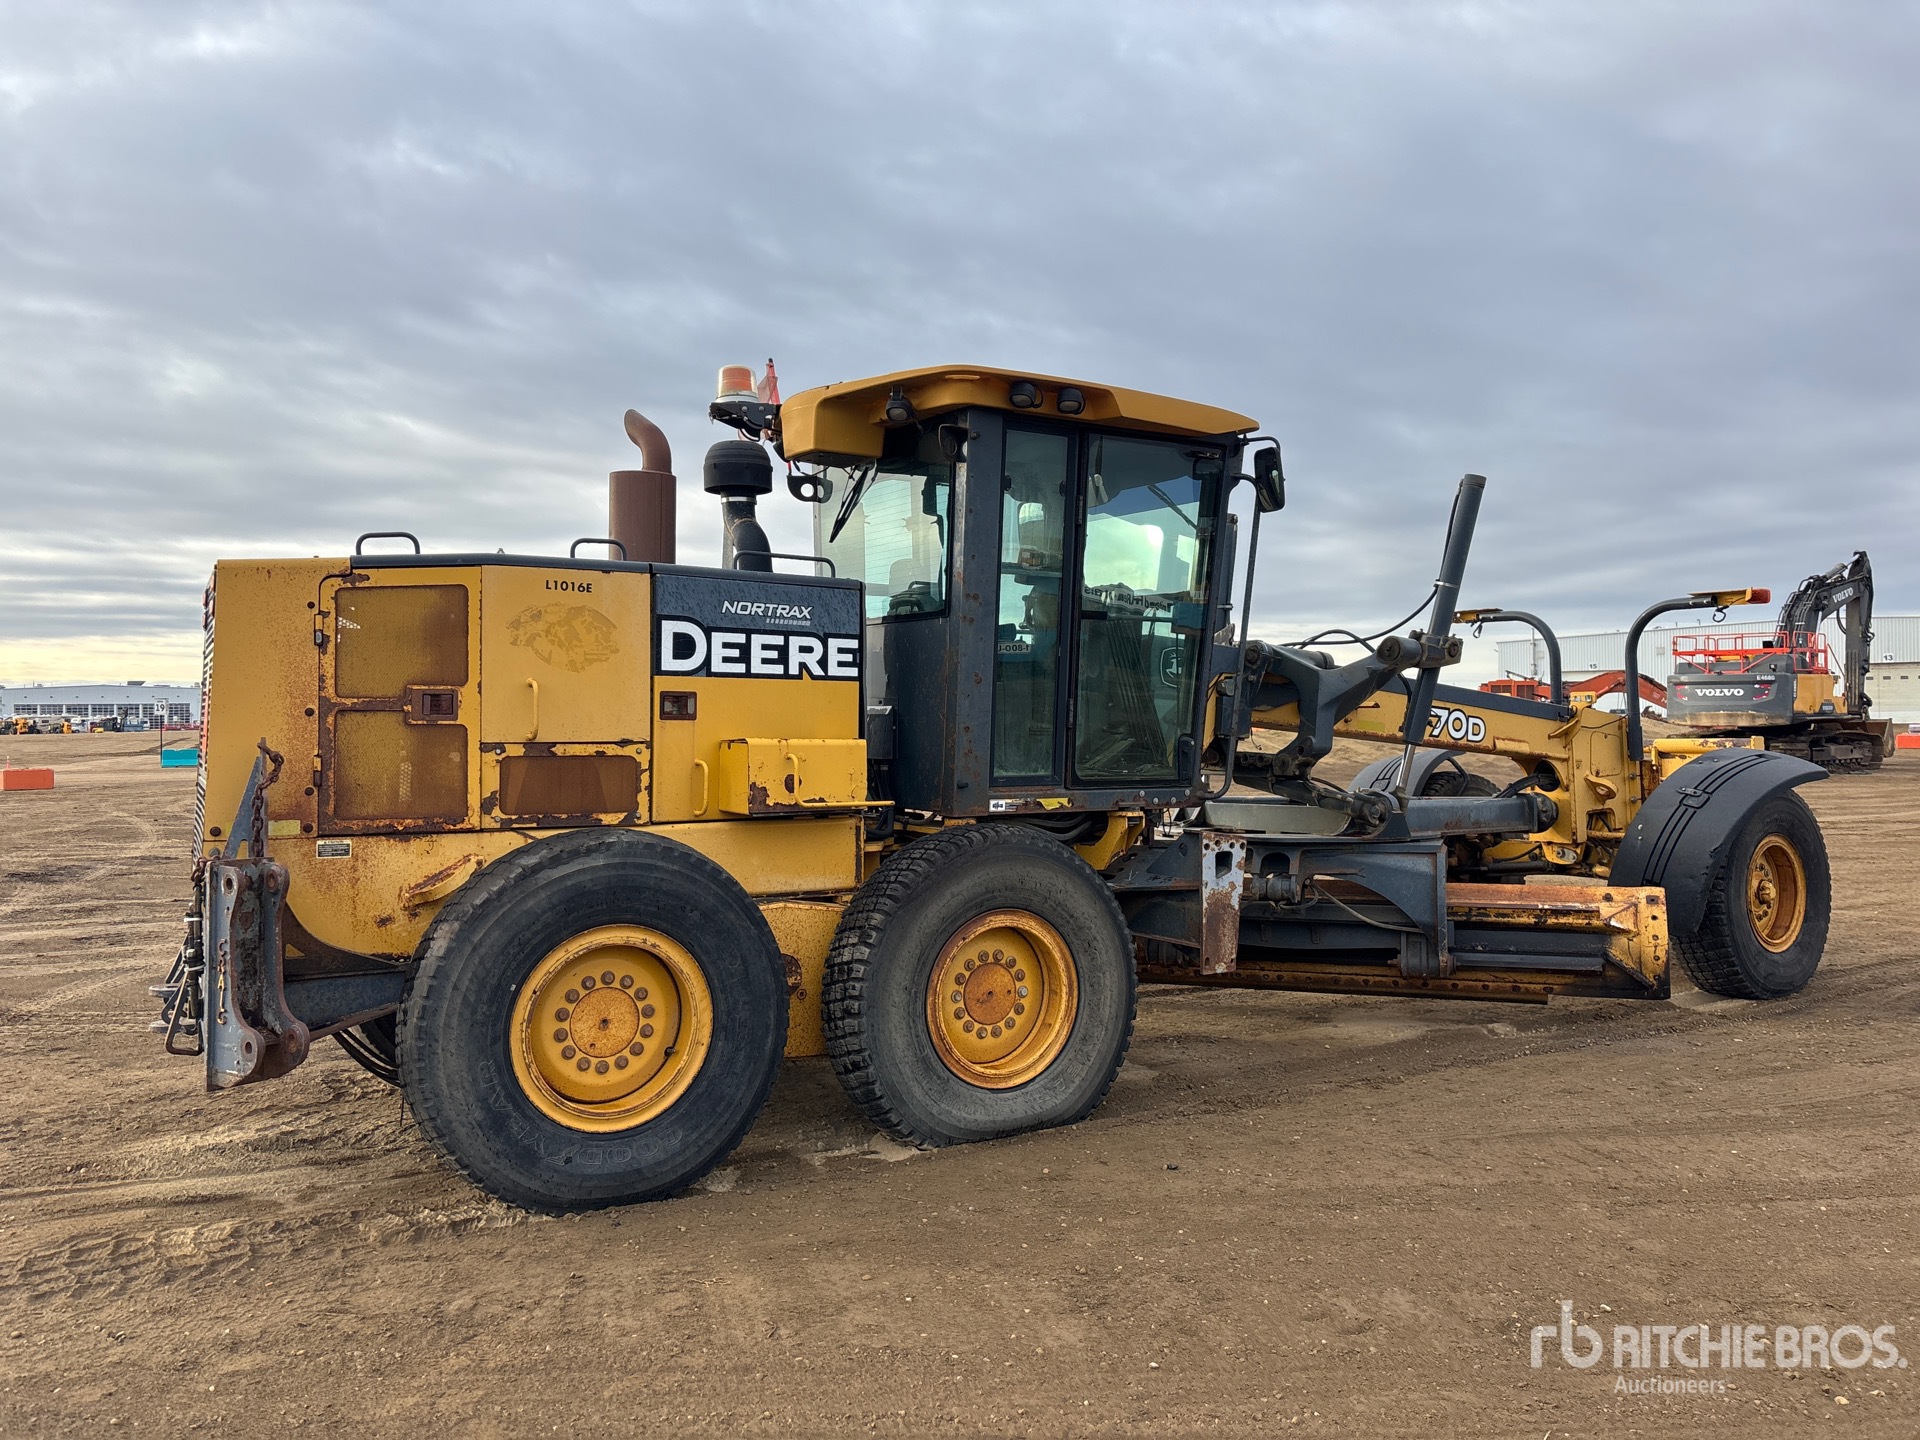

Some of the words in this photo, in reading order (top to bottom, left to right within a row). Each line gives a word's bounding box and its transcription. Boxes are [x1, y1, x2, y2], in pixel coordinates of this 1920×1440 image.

[545, 579, 593, 593] L1016E
[1832, 587, 1854, 603] VOLVO
[721, 600, 814, 619] NORTRAX
[660, 619, 859, 677] DEERE
[1695, 688, 1745, 697] VOLVO
[155, 703, 165, 711] 19
